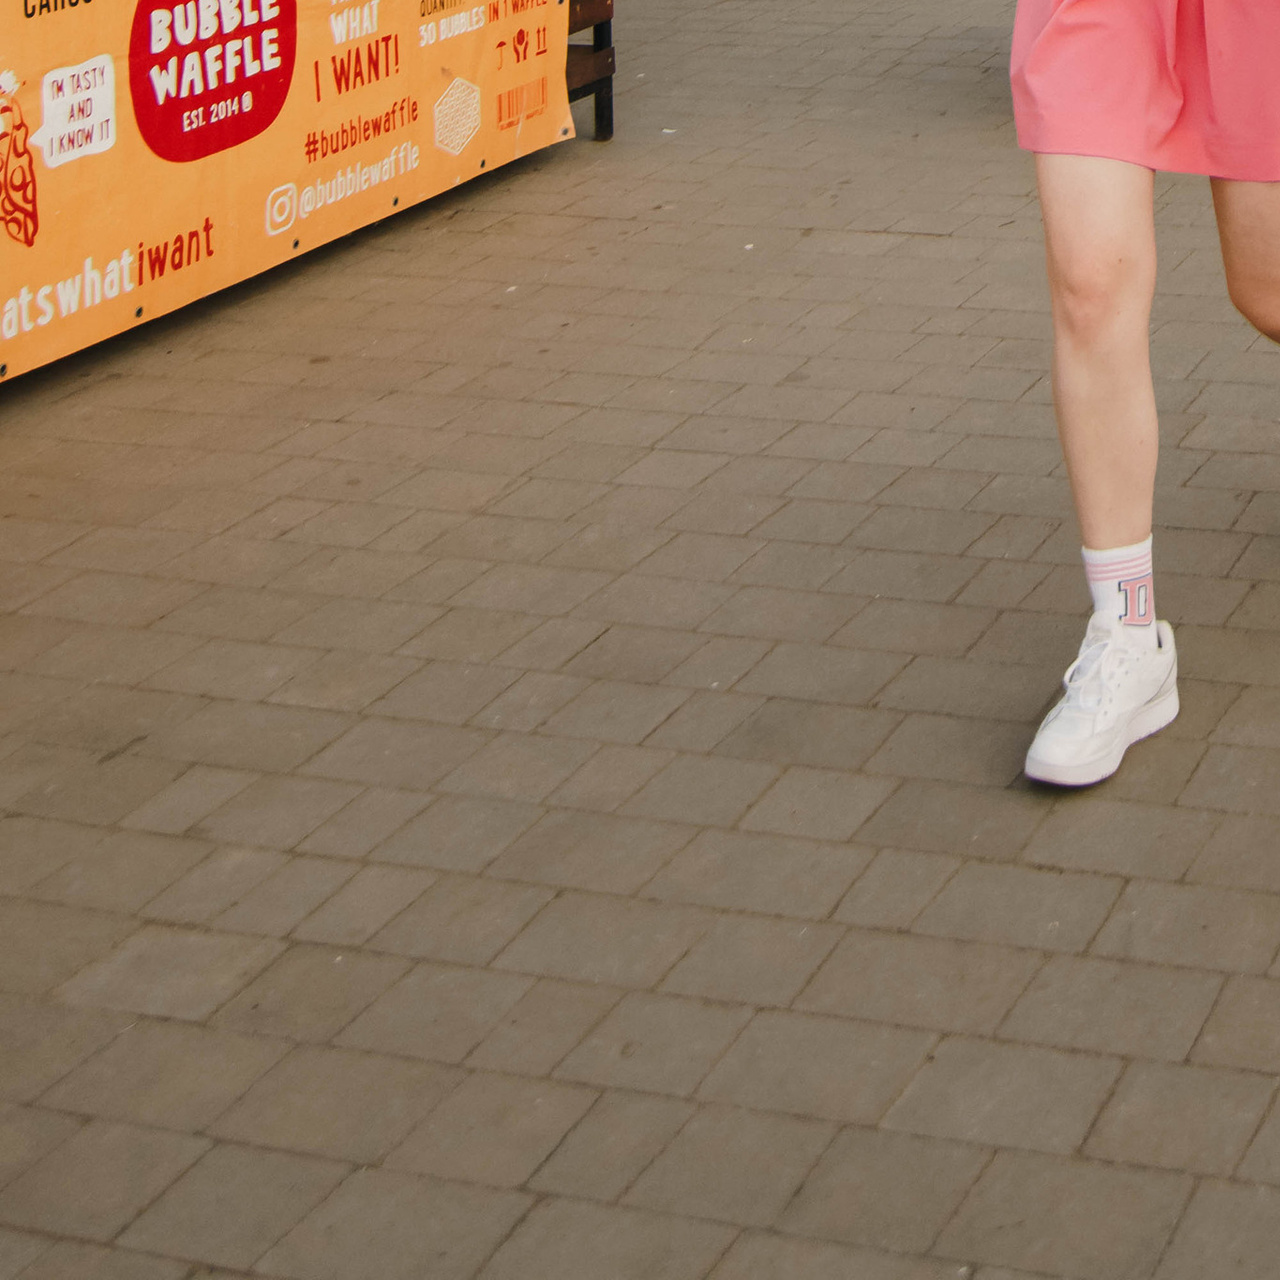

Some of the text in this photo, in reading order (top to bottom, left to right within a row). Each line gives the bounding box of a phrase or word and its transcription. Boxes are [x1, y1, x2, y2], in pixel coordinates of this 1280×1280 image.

[419, 22, 436, 47] 30
[440, 6, 486, 40] BUBBLES
[488, 0, 500, 23] IN
[504, 0, 508, 18] 1
[70, 64, 106, 96] TASTY
[148, 28, 282, 106] WAFFLE
[314, 34, 399, 102] I WANT!
[67, 97, 94, 124] AND
[182, 96, 240, 132] EST. 2014
[304, 96, 418, 163] #bubblewaffle
[50, 118, 110, 157] I KNOW IT
[300, 141, 420, 218] @bubblewaffle
